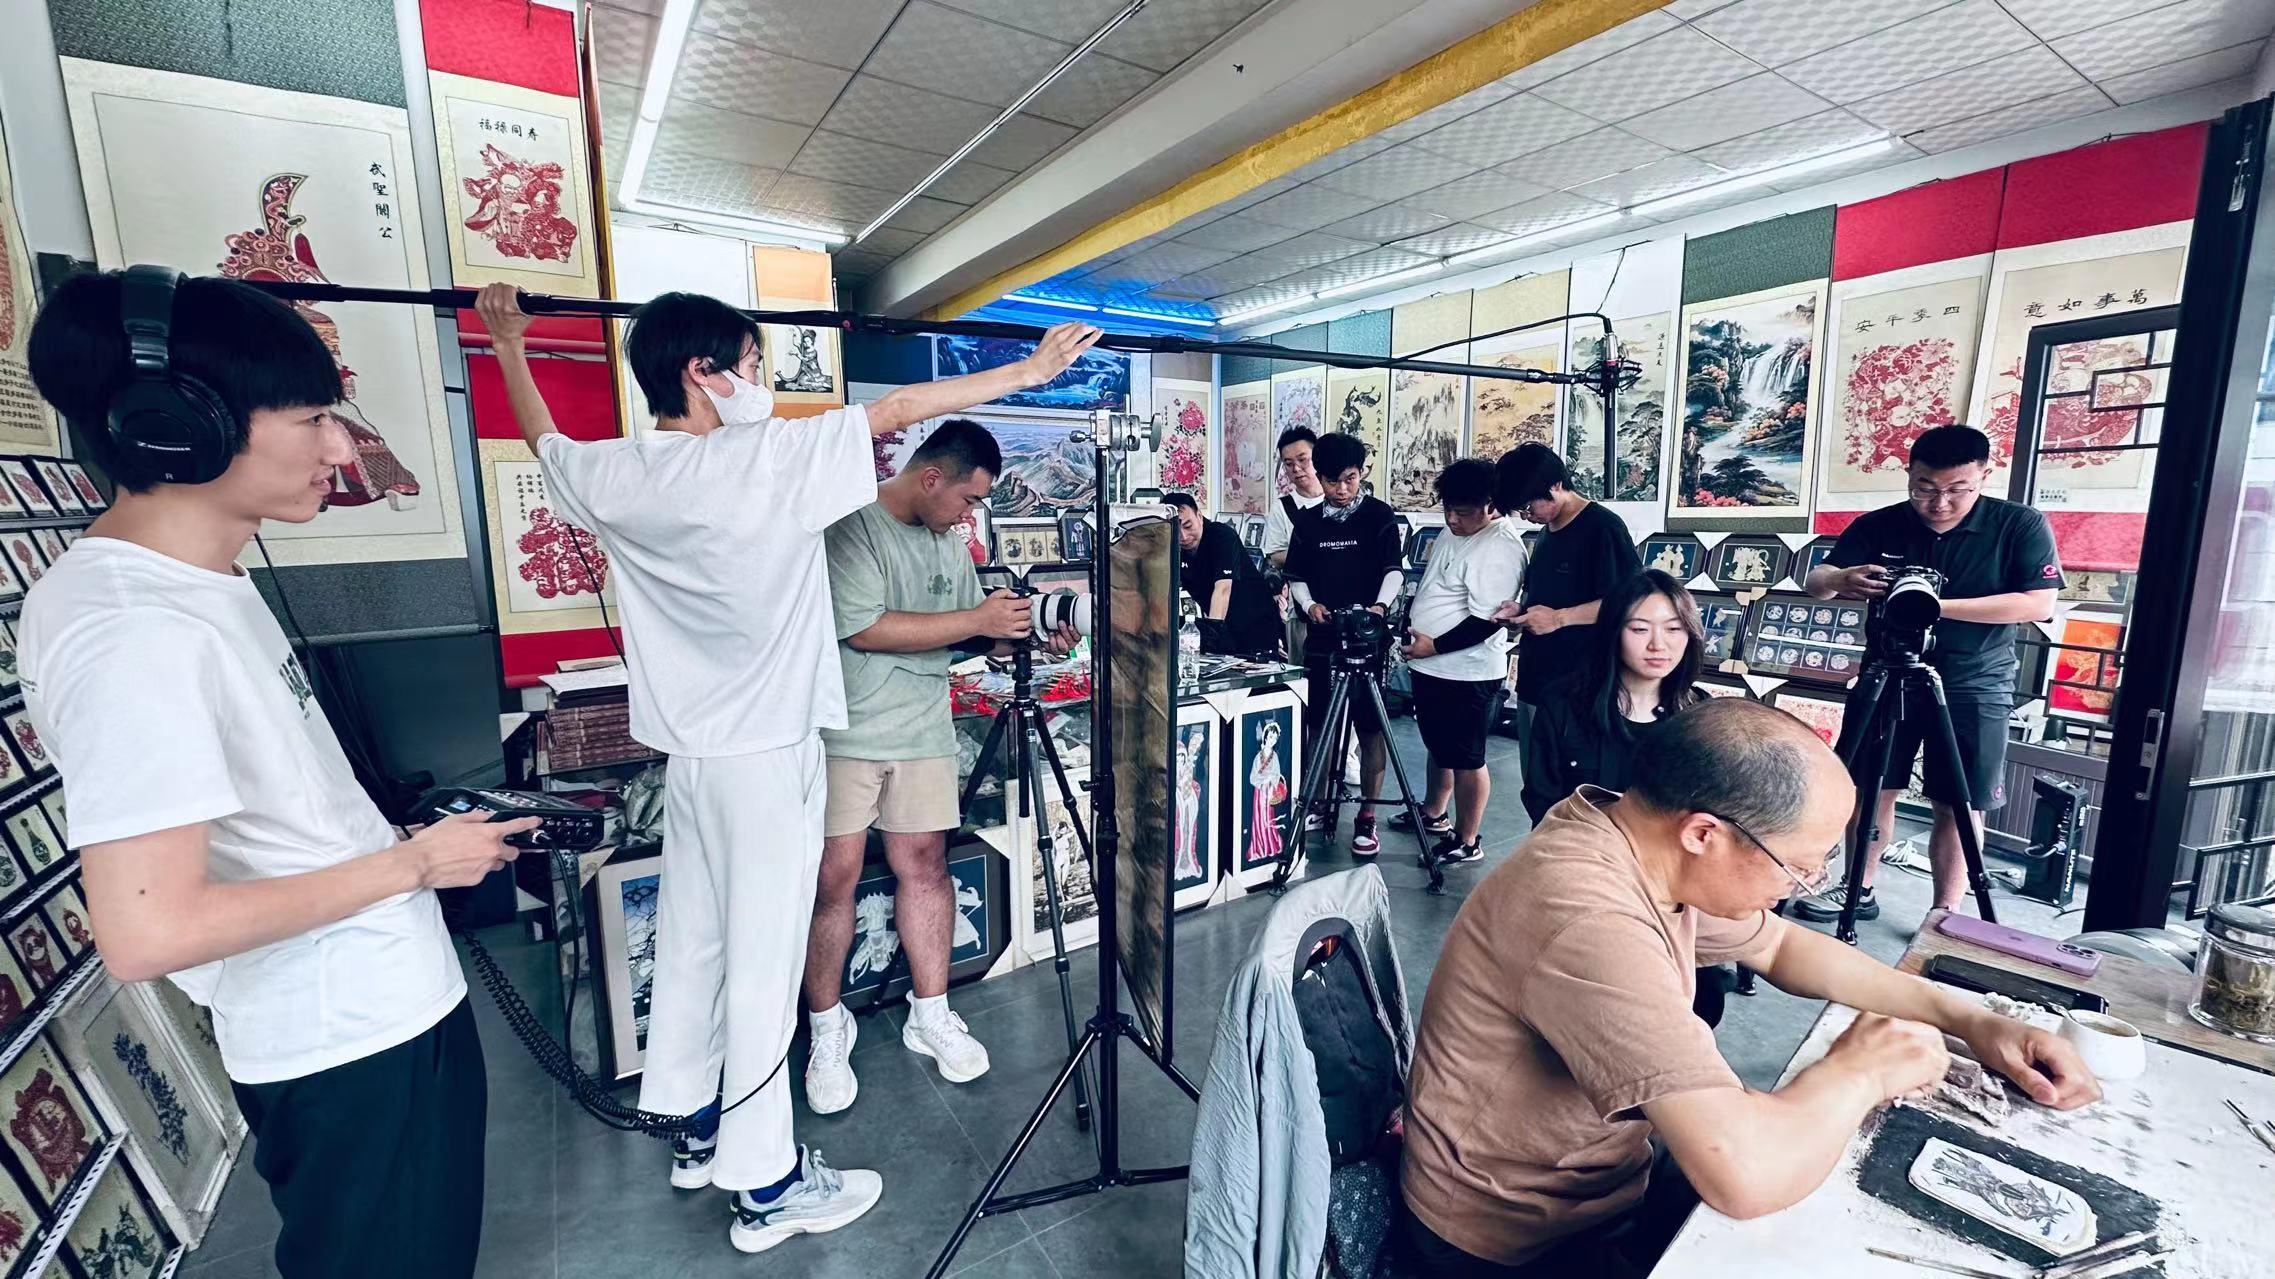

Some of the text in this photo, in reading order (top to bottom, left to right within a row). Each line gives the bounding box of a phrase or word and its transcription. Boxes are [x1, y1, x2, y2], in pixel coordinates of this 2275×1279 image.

[2023, 288, 2148, 318] 萬事如意
[1855, 305, 1960, 333] 四季平安
